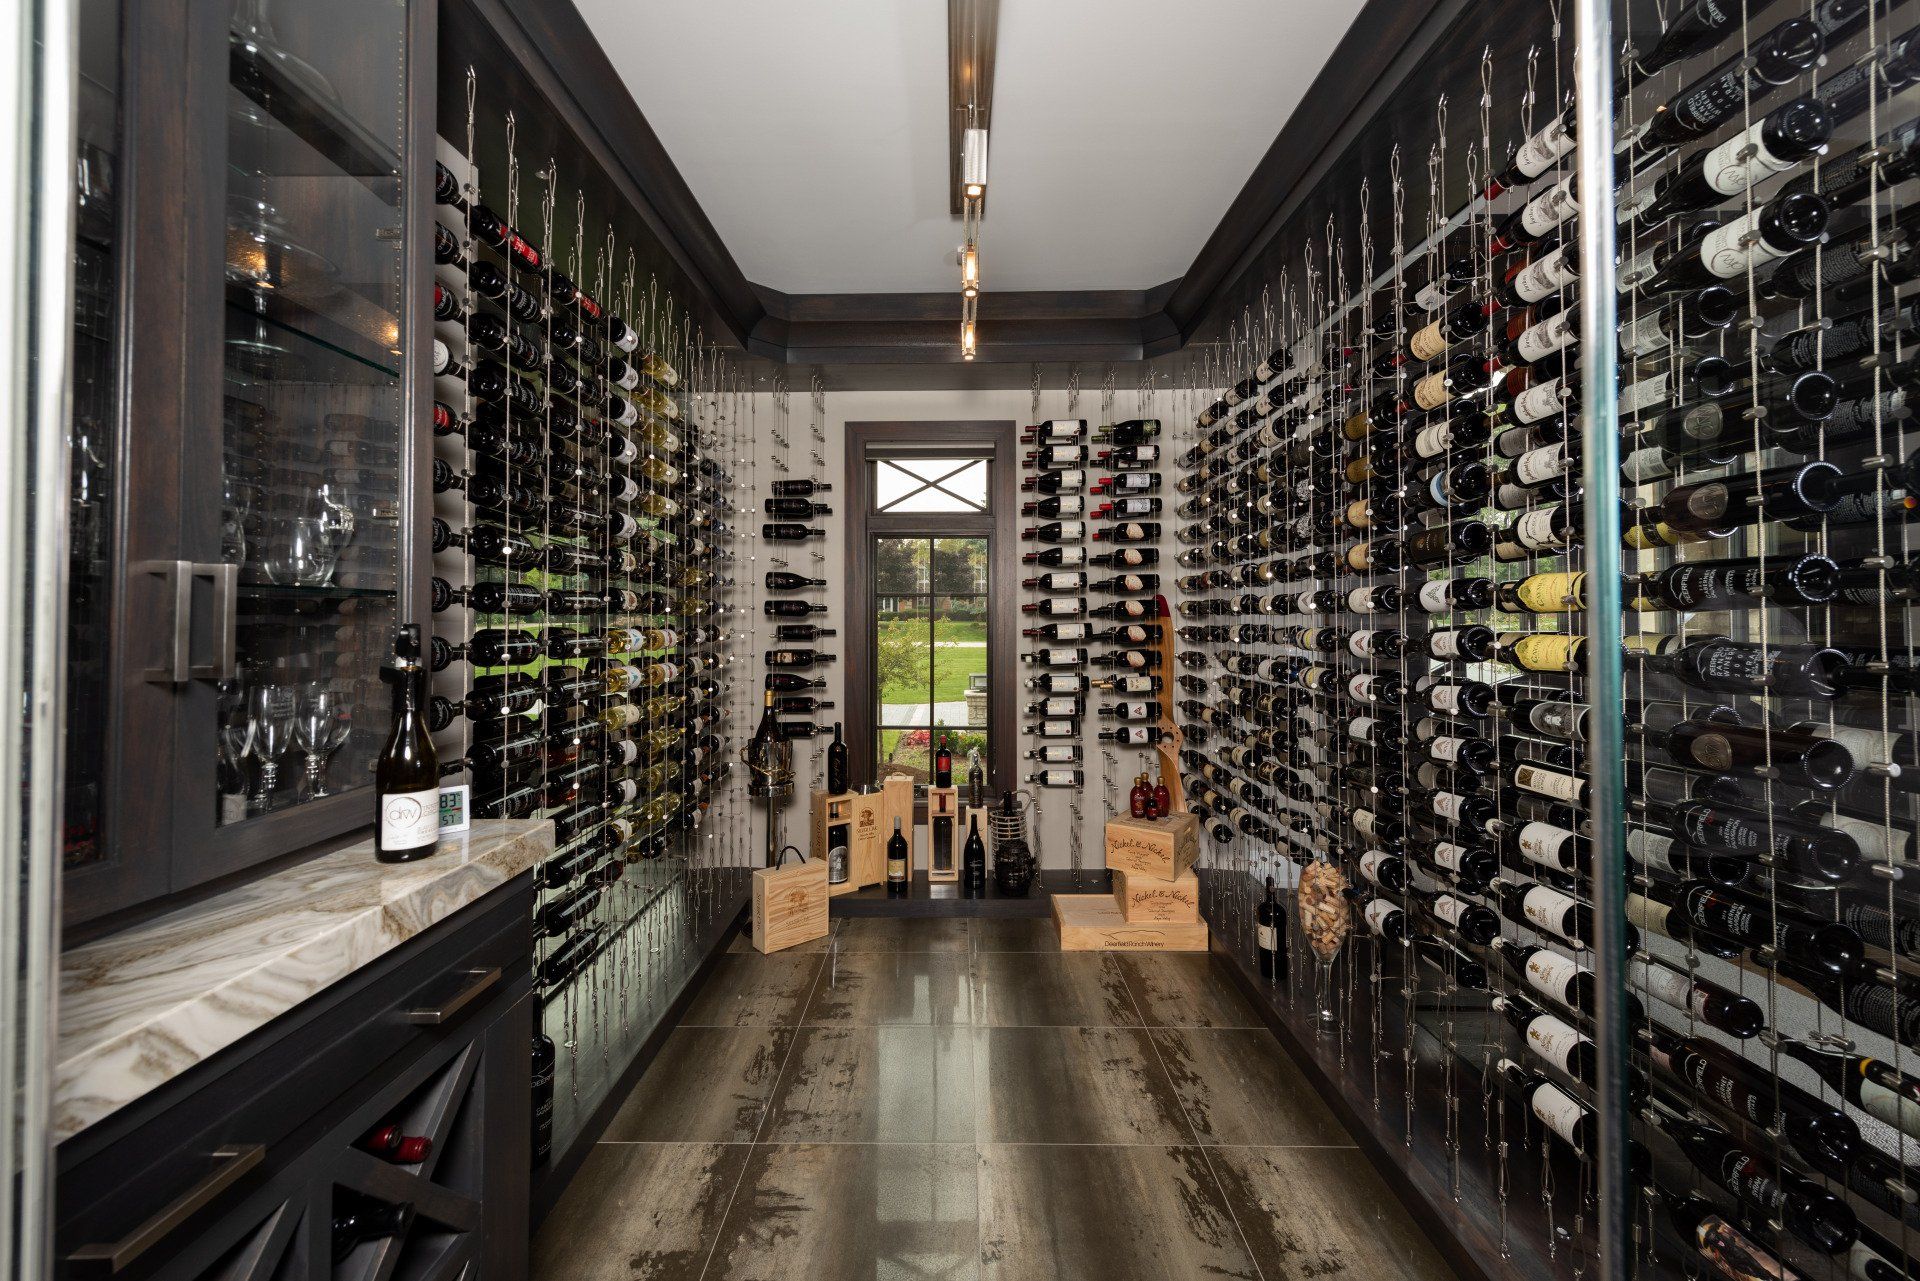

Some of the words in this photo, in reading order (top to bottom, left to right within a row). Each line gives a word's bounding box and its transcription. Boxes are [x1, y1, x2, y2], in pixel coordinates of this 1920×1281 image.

[1687, 97, 1710, 123] DEERFIELD
[1693, 92, 1716, 119] RANCH
[1700, 89, 1722, 115] WINERY
[1681, 566, 1694, 604] DEERFIELD
[1703, 569, 1711, 599] CABERNET
[1709, 646, 1725, 676] DEERFIELD
[1716, 647, 1732, 677] RANCH
[1723, 647, 1738, 677] WINERY
[1734, 648, 1749, 678] 2001
[1745, 648, 1761, 678] SYRAH
[440, 793, 456, 808] 83
[443, 814, 454, 826] 57
[1696, 808, 1711, 845] DEERFIELD
[1724, 818, 1734, 848] CABERNET
[1110, 838, 1134, 854] Nickel
[1142, 842, 1171, 864] Nickel
[1131, 889, 1158, 908] Nickel
[1165, 890, 1195, 908] Nickel
[1697, 889, 1713, 927] DEERFIELD
[1728, 902, 1739, 934] CABERNET
